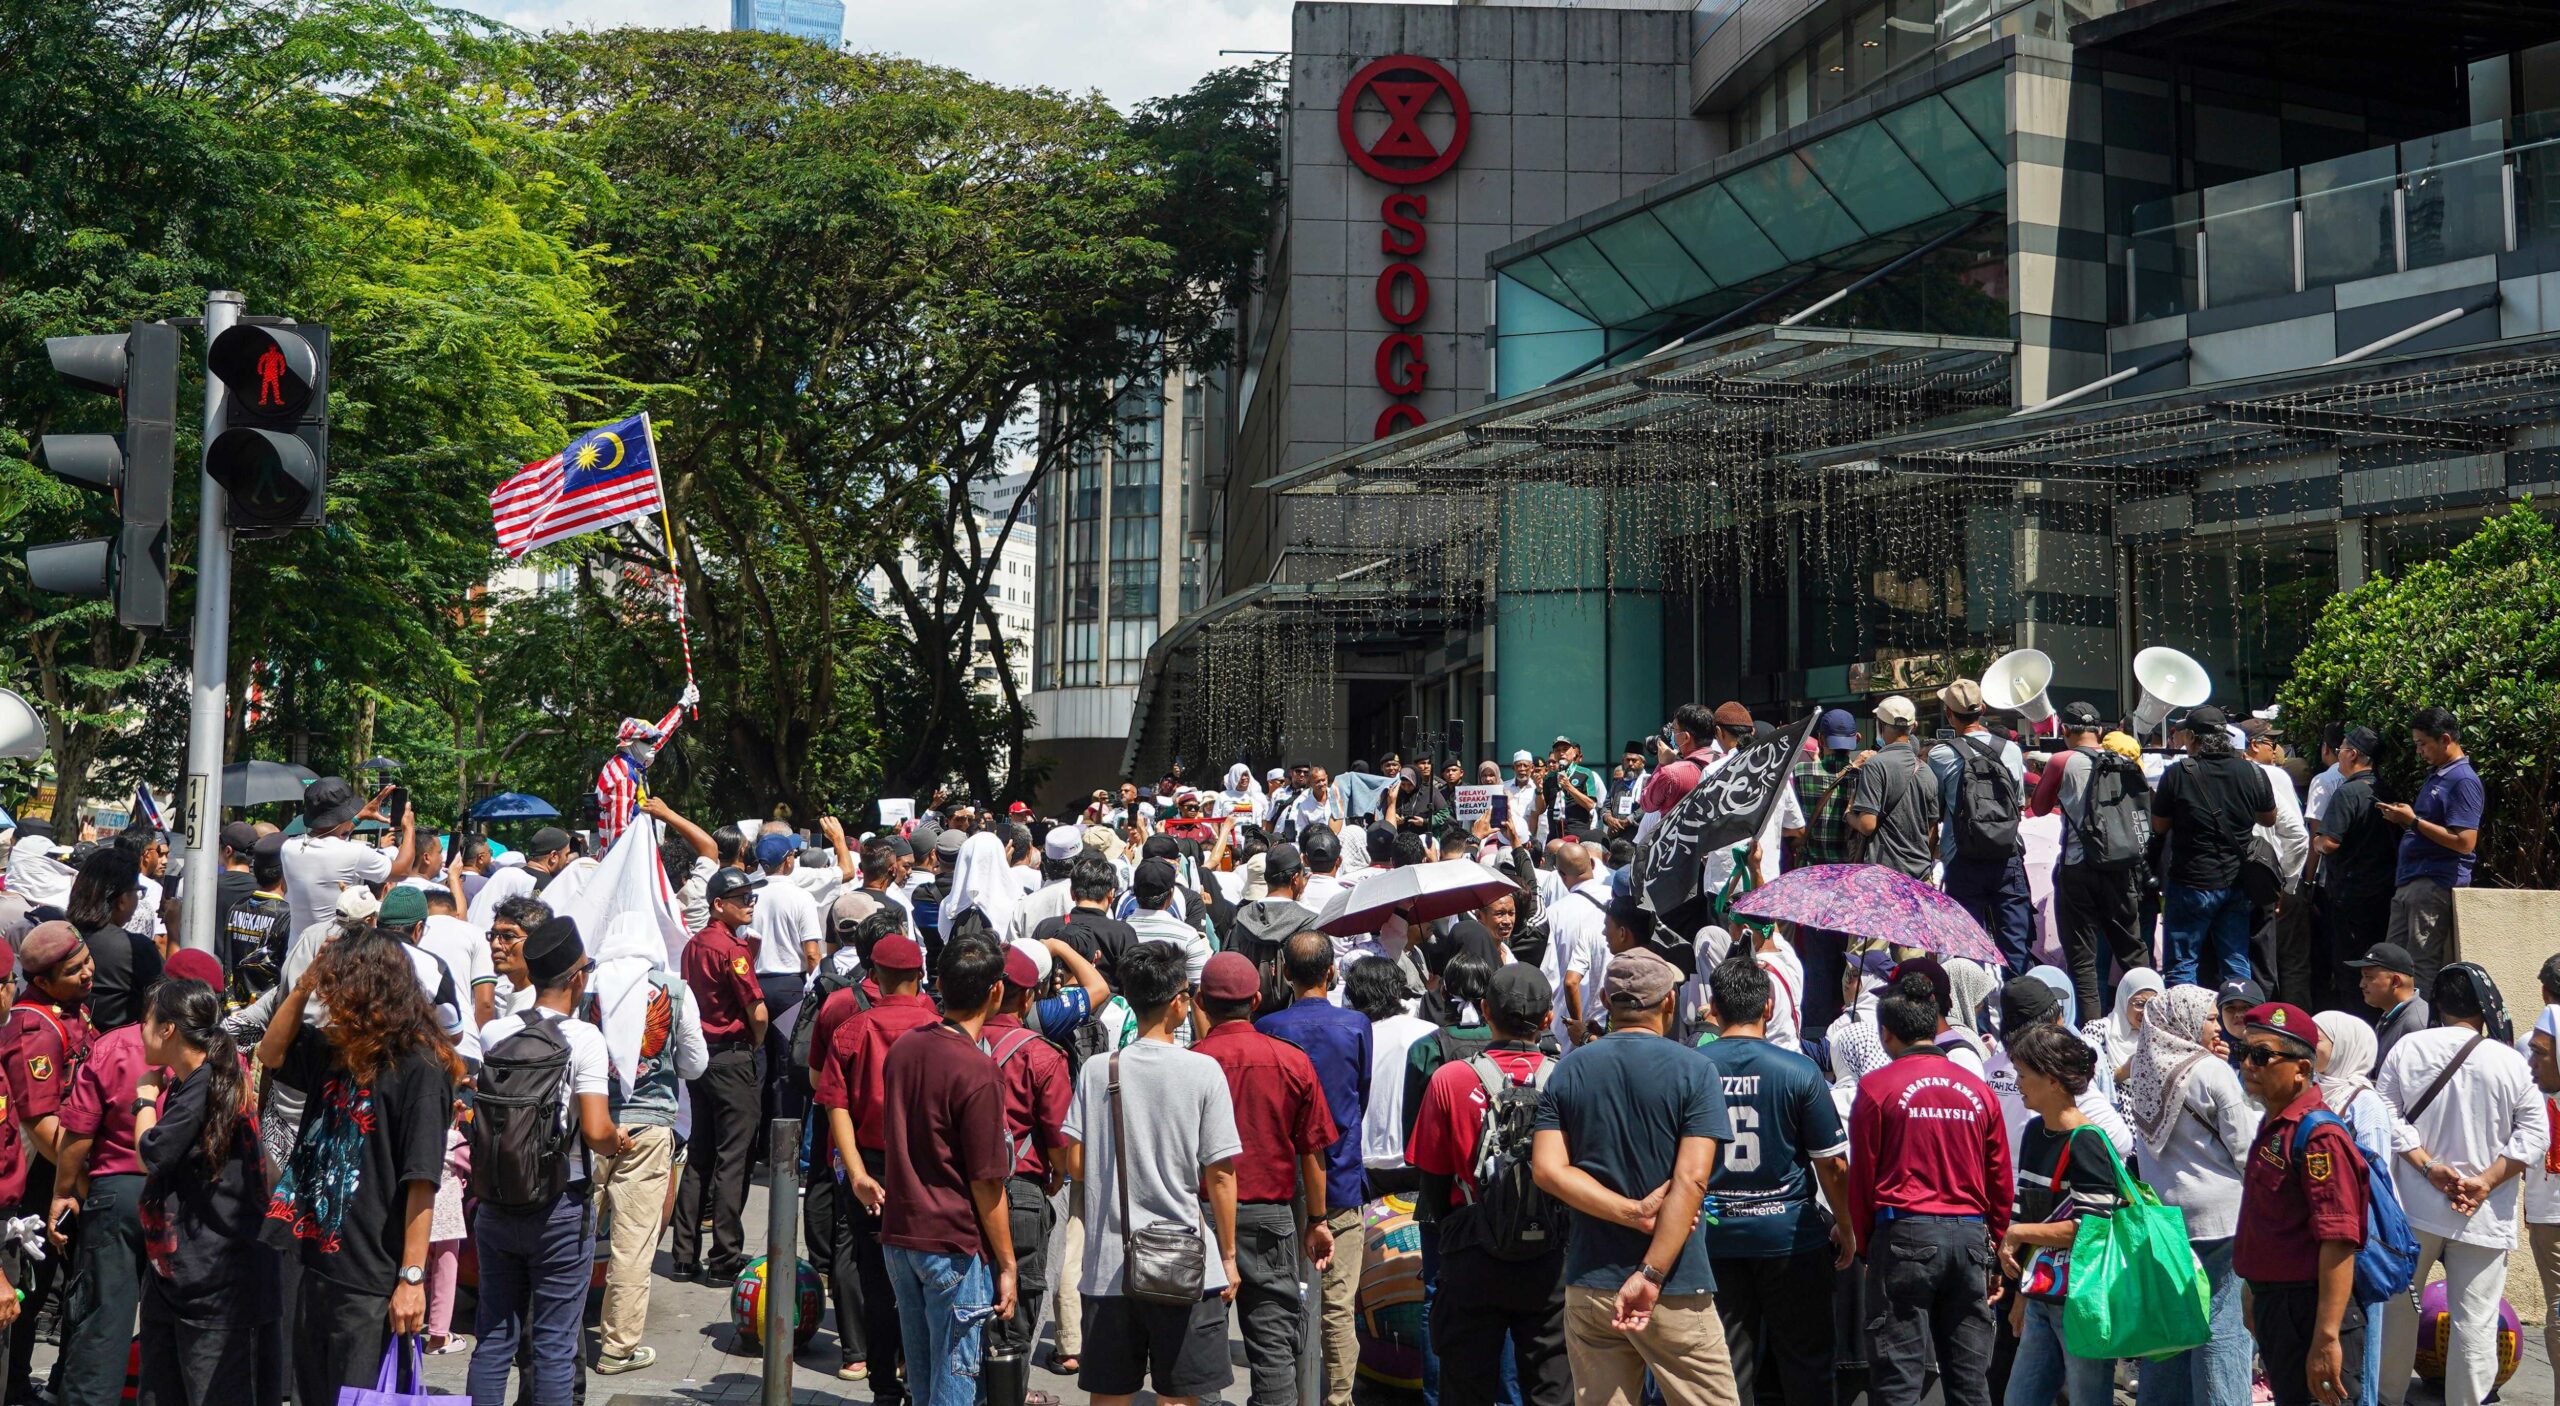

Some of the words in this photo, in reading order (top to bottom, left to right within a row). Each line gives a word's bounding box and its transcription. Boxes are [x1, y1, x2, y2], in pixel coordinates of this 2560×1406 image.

[186, 778, 197, 846] 149
[228, 910, 275, 931] LANGKAWI
[1897, 1077, 1950, 1110] JABATAN
[1952, 1081, 1985, 1114] AMAL
[1986, 1080, 2005, 1091] NTAH
[2005, 1082, 2020, 1092] ICE
[1908, 1106, 1975, 1122] MALAYSIA
[1724, 1105, 1761, 1173] 6
[1726, 1204, 1786, 1217] chartered
